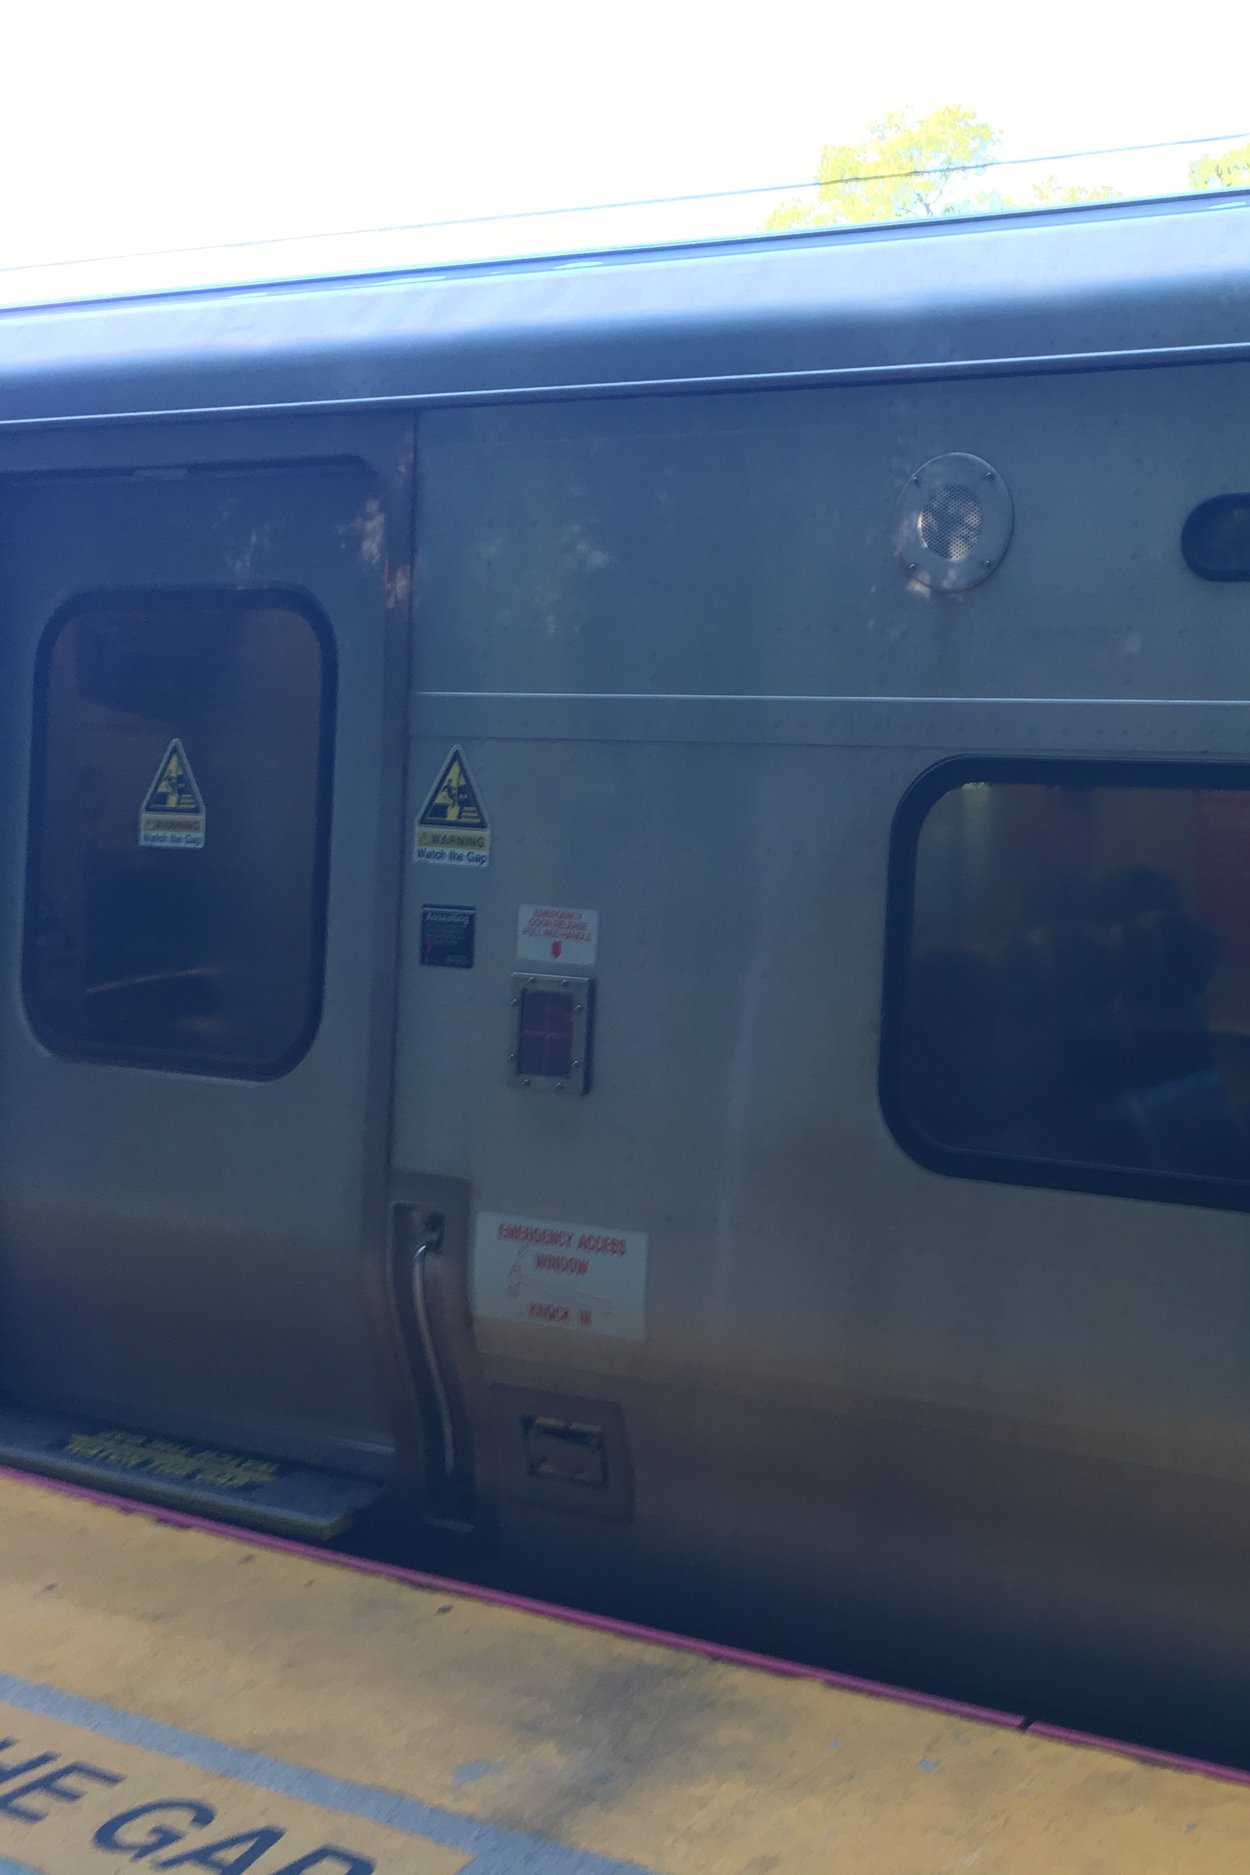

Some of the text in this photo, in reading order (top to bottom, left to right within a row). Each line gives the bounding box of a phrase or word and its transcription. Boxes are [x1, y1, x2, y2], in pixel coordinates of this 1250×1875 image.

[432, 833, 485, 848] WARNING
[417, 847, 488, 866] Watch the Gap
[499, 1223, 627, 1256] EMERGENCY ACCESS
[536, 1253, 590, 1275] WINDOW
